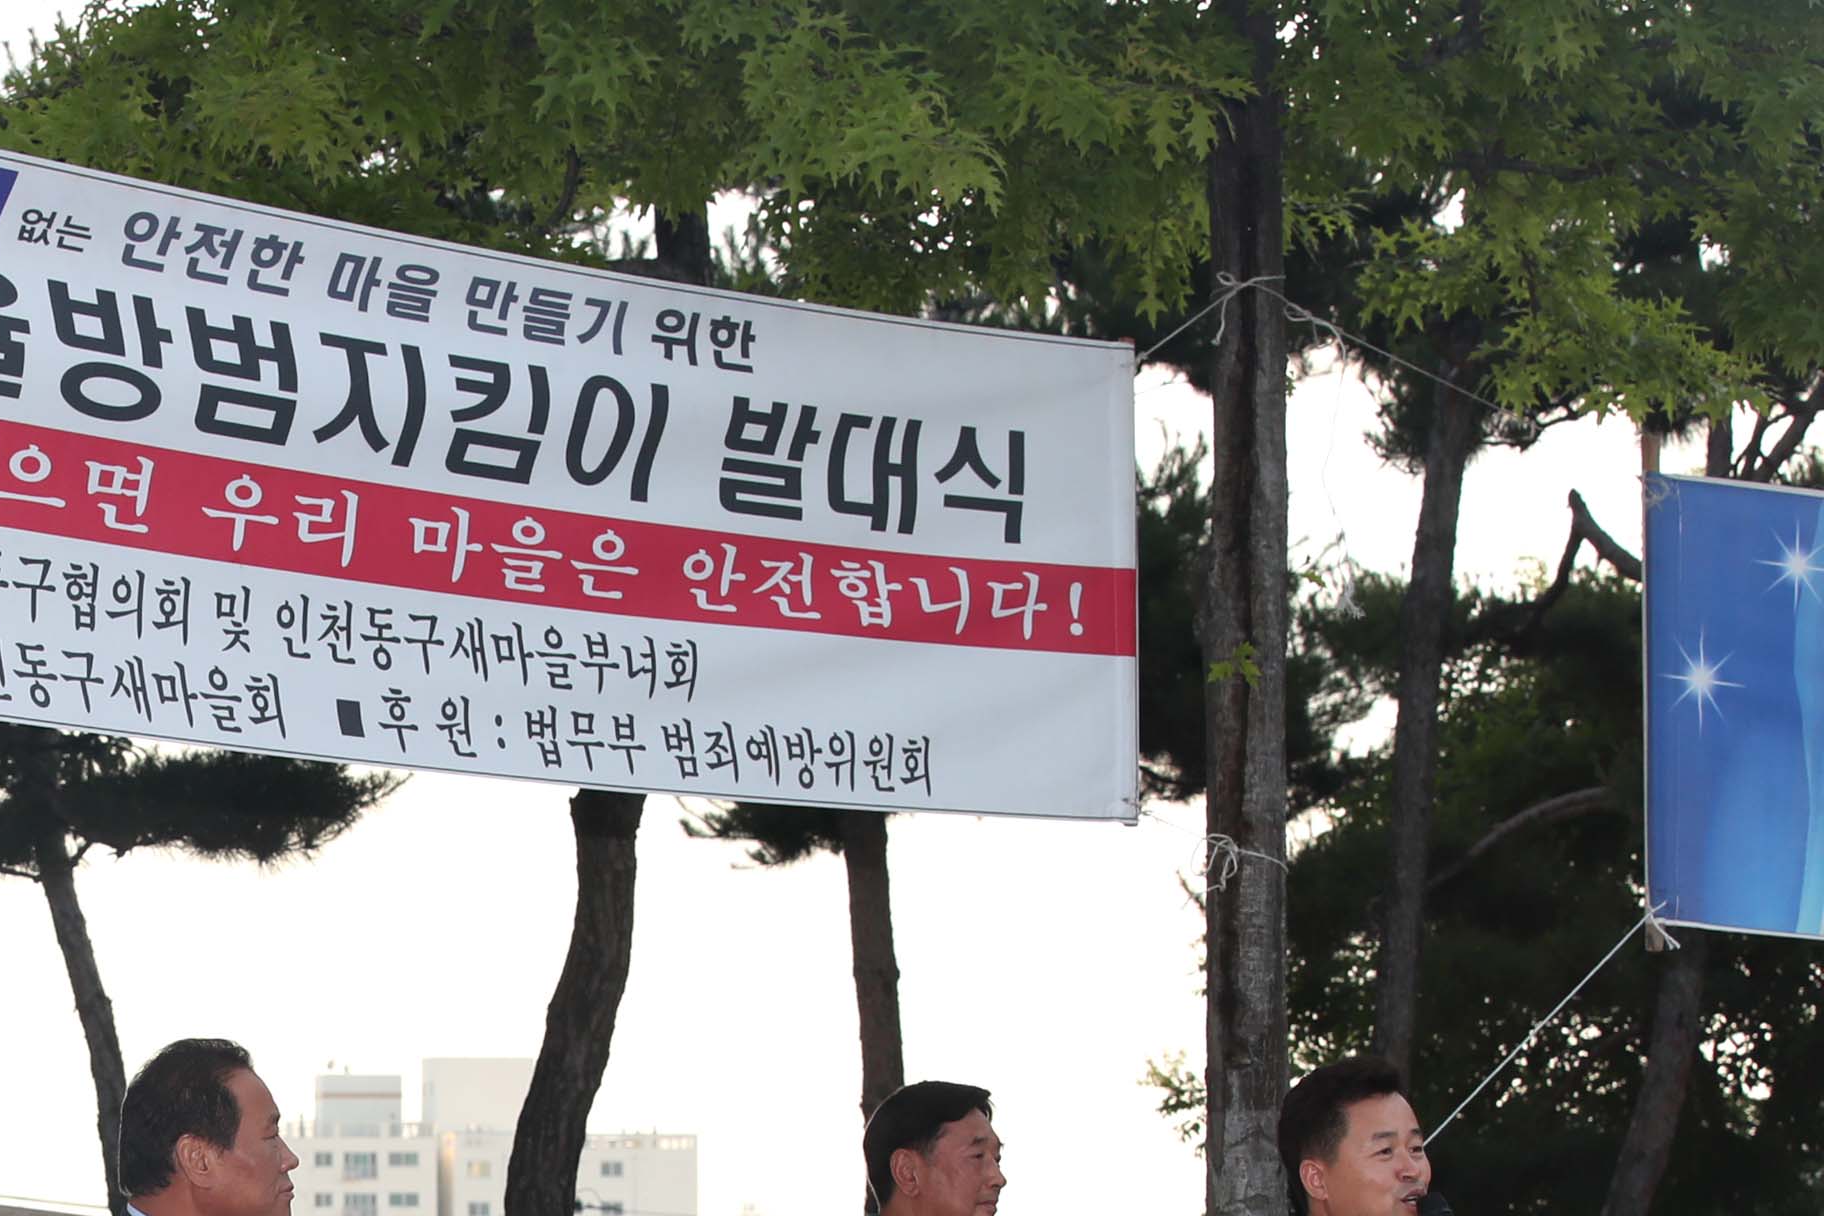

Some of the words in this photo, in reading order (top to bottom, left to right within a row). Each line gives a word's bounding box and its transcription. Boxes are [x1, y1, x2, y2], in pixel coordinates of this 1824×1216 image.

[18, 209, 91, 252] 없는
[121, 211, 304, 296] 안전한
[328, 253, 439, 322] 마을
[466, 277, 628, 355] 만들기
[652, 309, 756, 373] 위한
[719, 396, 1024, 544] 발대식
[202, 475, 358, 567] 우리
[409, 507, 638, 599] 마을은
[684, 544, 1084, 639] 안전합니다!
[215, 586, 250, 652] 및
[277, 594, 697, 702] 인천동구새마을부녀회
[525, 705, 646, 775] 법무부
[661, 718, 931, 796] 범죄예방위원회
